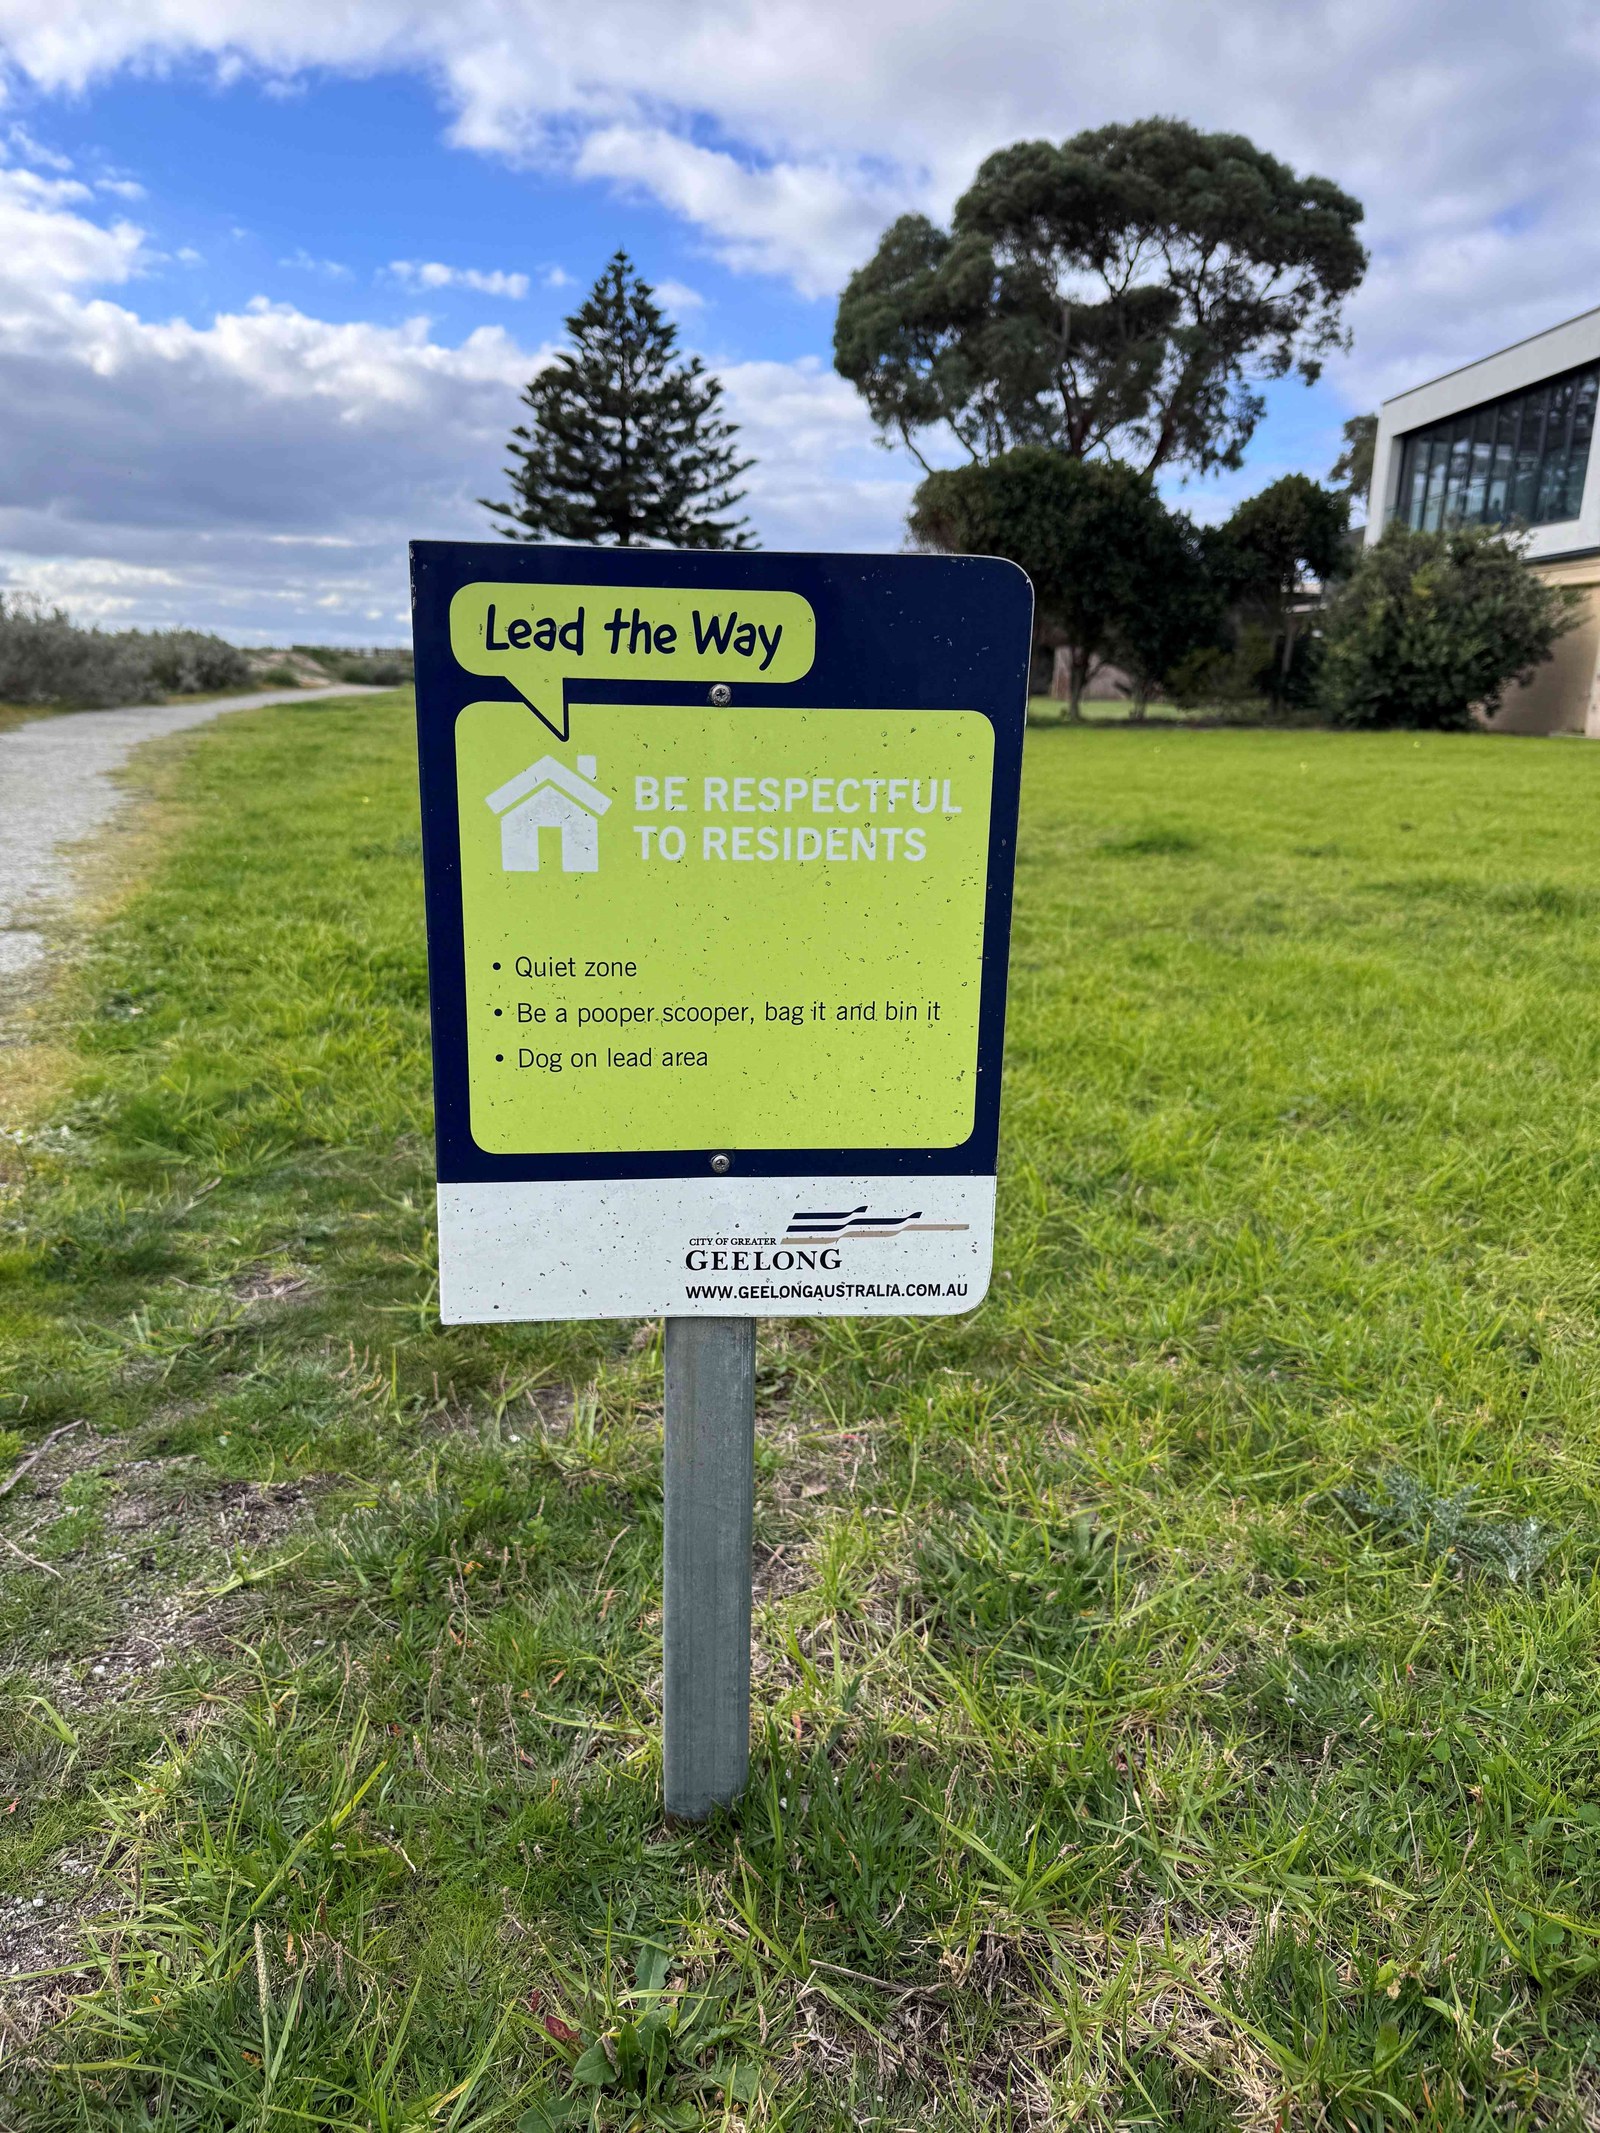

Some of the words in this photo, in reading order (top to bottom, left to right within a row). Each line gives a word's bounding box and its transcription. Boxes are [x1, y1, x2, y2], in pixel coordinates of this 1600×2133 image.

[485, 604, 584, 656] Lead
[604, 608, 678, 655] the
[691, 610, 782, 671] Way
[634, 776, 688, 812] BE
[704, 777, 962, 815] RESPECTFUL
[634, 826, 687, 861] TO
[703, 826, 927, 862] RESIDENTS
[515, 956, 577, 978] Quiet
[584, 960, 638, 978] zone
[517, 1003, 548, 1024] Be
[555, 1008, 567, 1024] a
[578, 1007, 655, 1029] pooper
[663, 1006, 756, 1027] scooper,
[765, 1002, 804, 1027] bag
[812, 1002, 826, 1022] it
[836, 1001, 876, 1022] and
[885, 1001, 918, 1021] bin
[927, 1002, 941, 1021] it
[518, 1048, 562, 1073] Dog
[570, 1052, 598, 1068] on
[607, 1047, 653, 1067] lead
[662, 1051, 708, 1067] area
[689, 1237, 714, 1246] CITY
[715, 1237, 729, 1246] OF
[730, 1237, 777, 1246] GREATER
[685, 1248, 842, 1271] GEELONG
[685, 1283, 968, 1299] WWW.GEELONGAUSTRALIA.COM.AU
